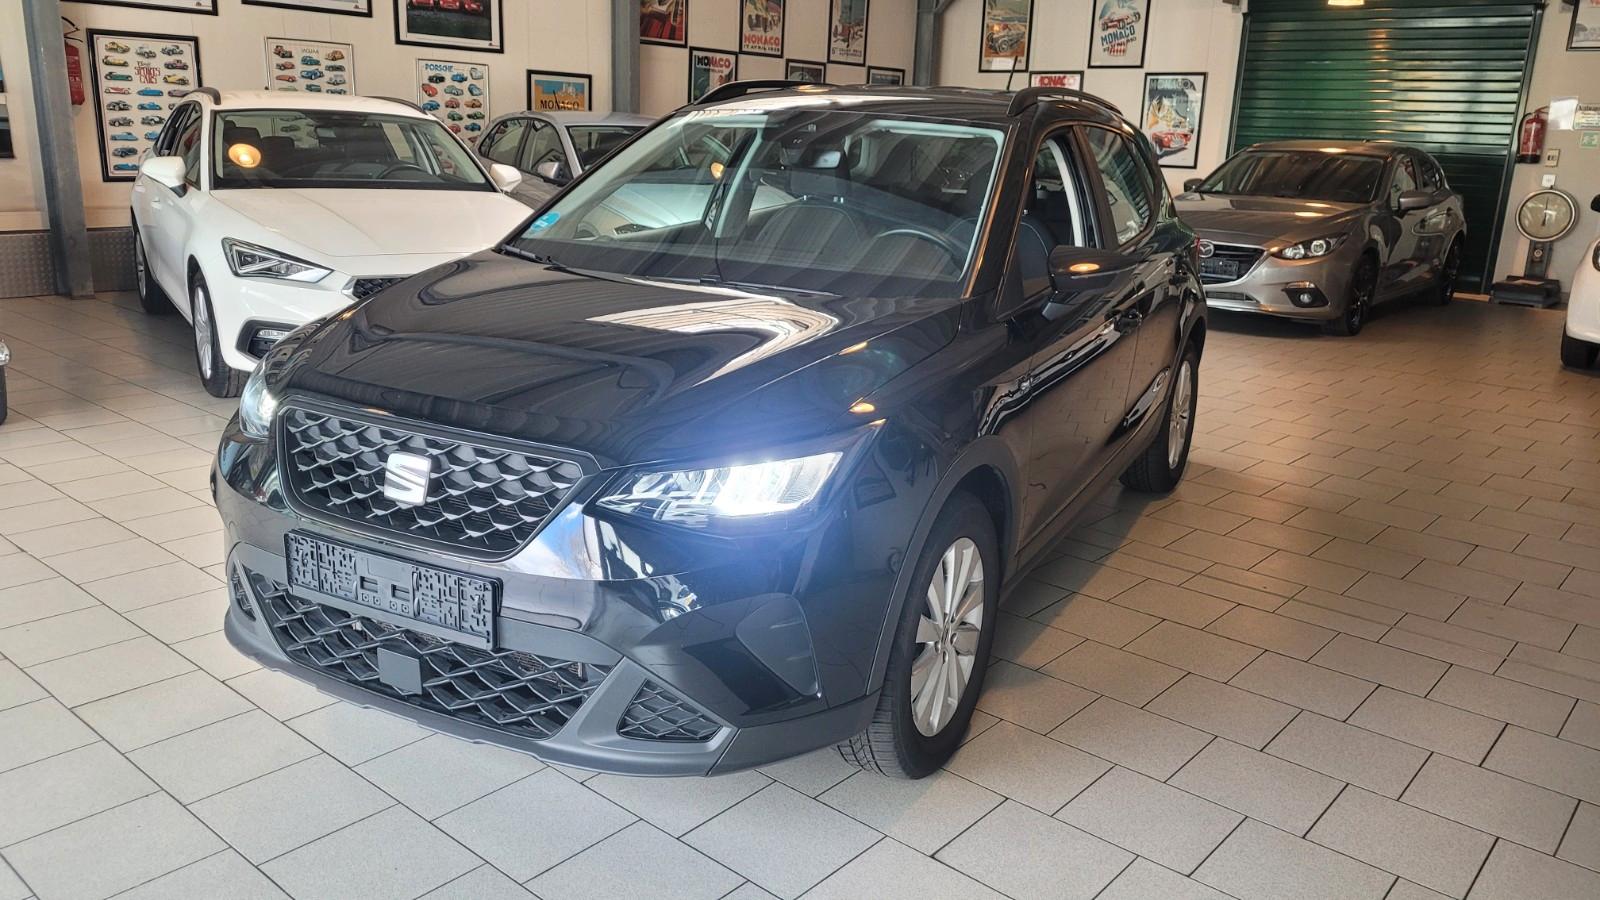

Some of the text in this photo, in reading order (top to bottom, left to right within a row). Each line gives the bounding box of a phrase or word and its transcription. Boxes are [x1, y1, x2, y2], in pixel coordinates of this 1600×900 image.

[744, 33, 780, 47] MONACO
[1101, 25, 1135, 46] MONACO
[424, 63, 454, 73] PORSCHE
[696, 55, 731, 69] MONACO
[540, 99, 580, 110] MONACO
